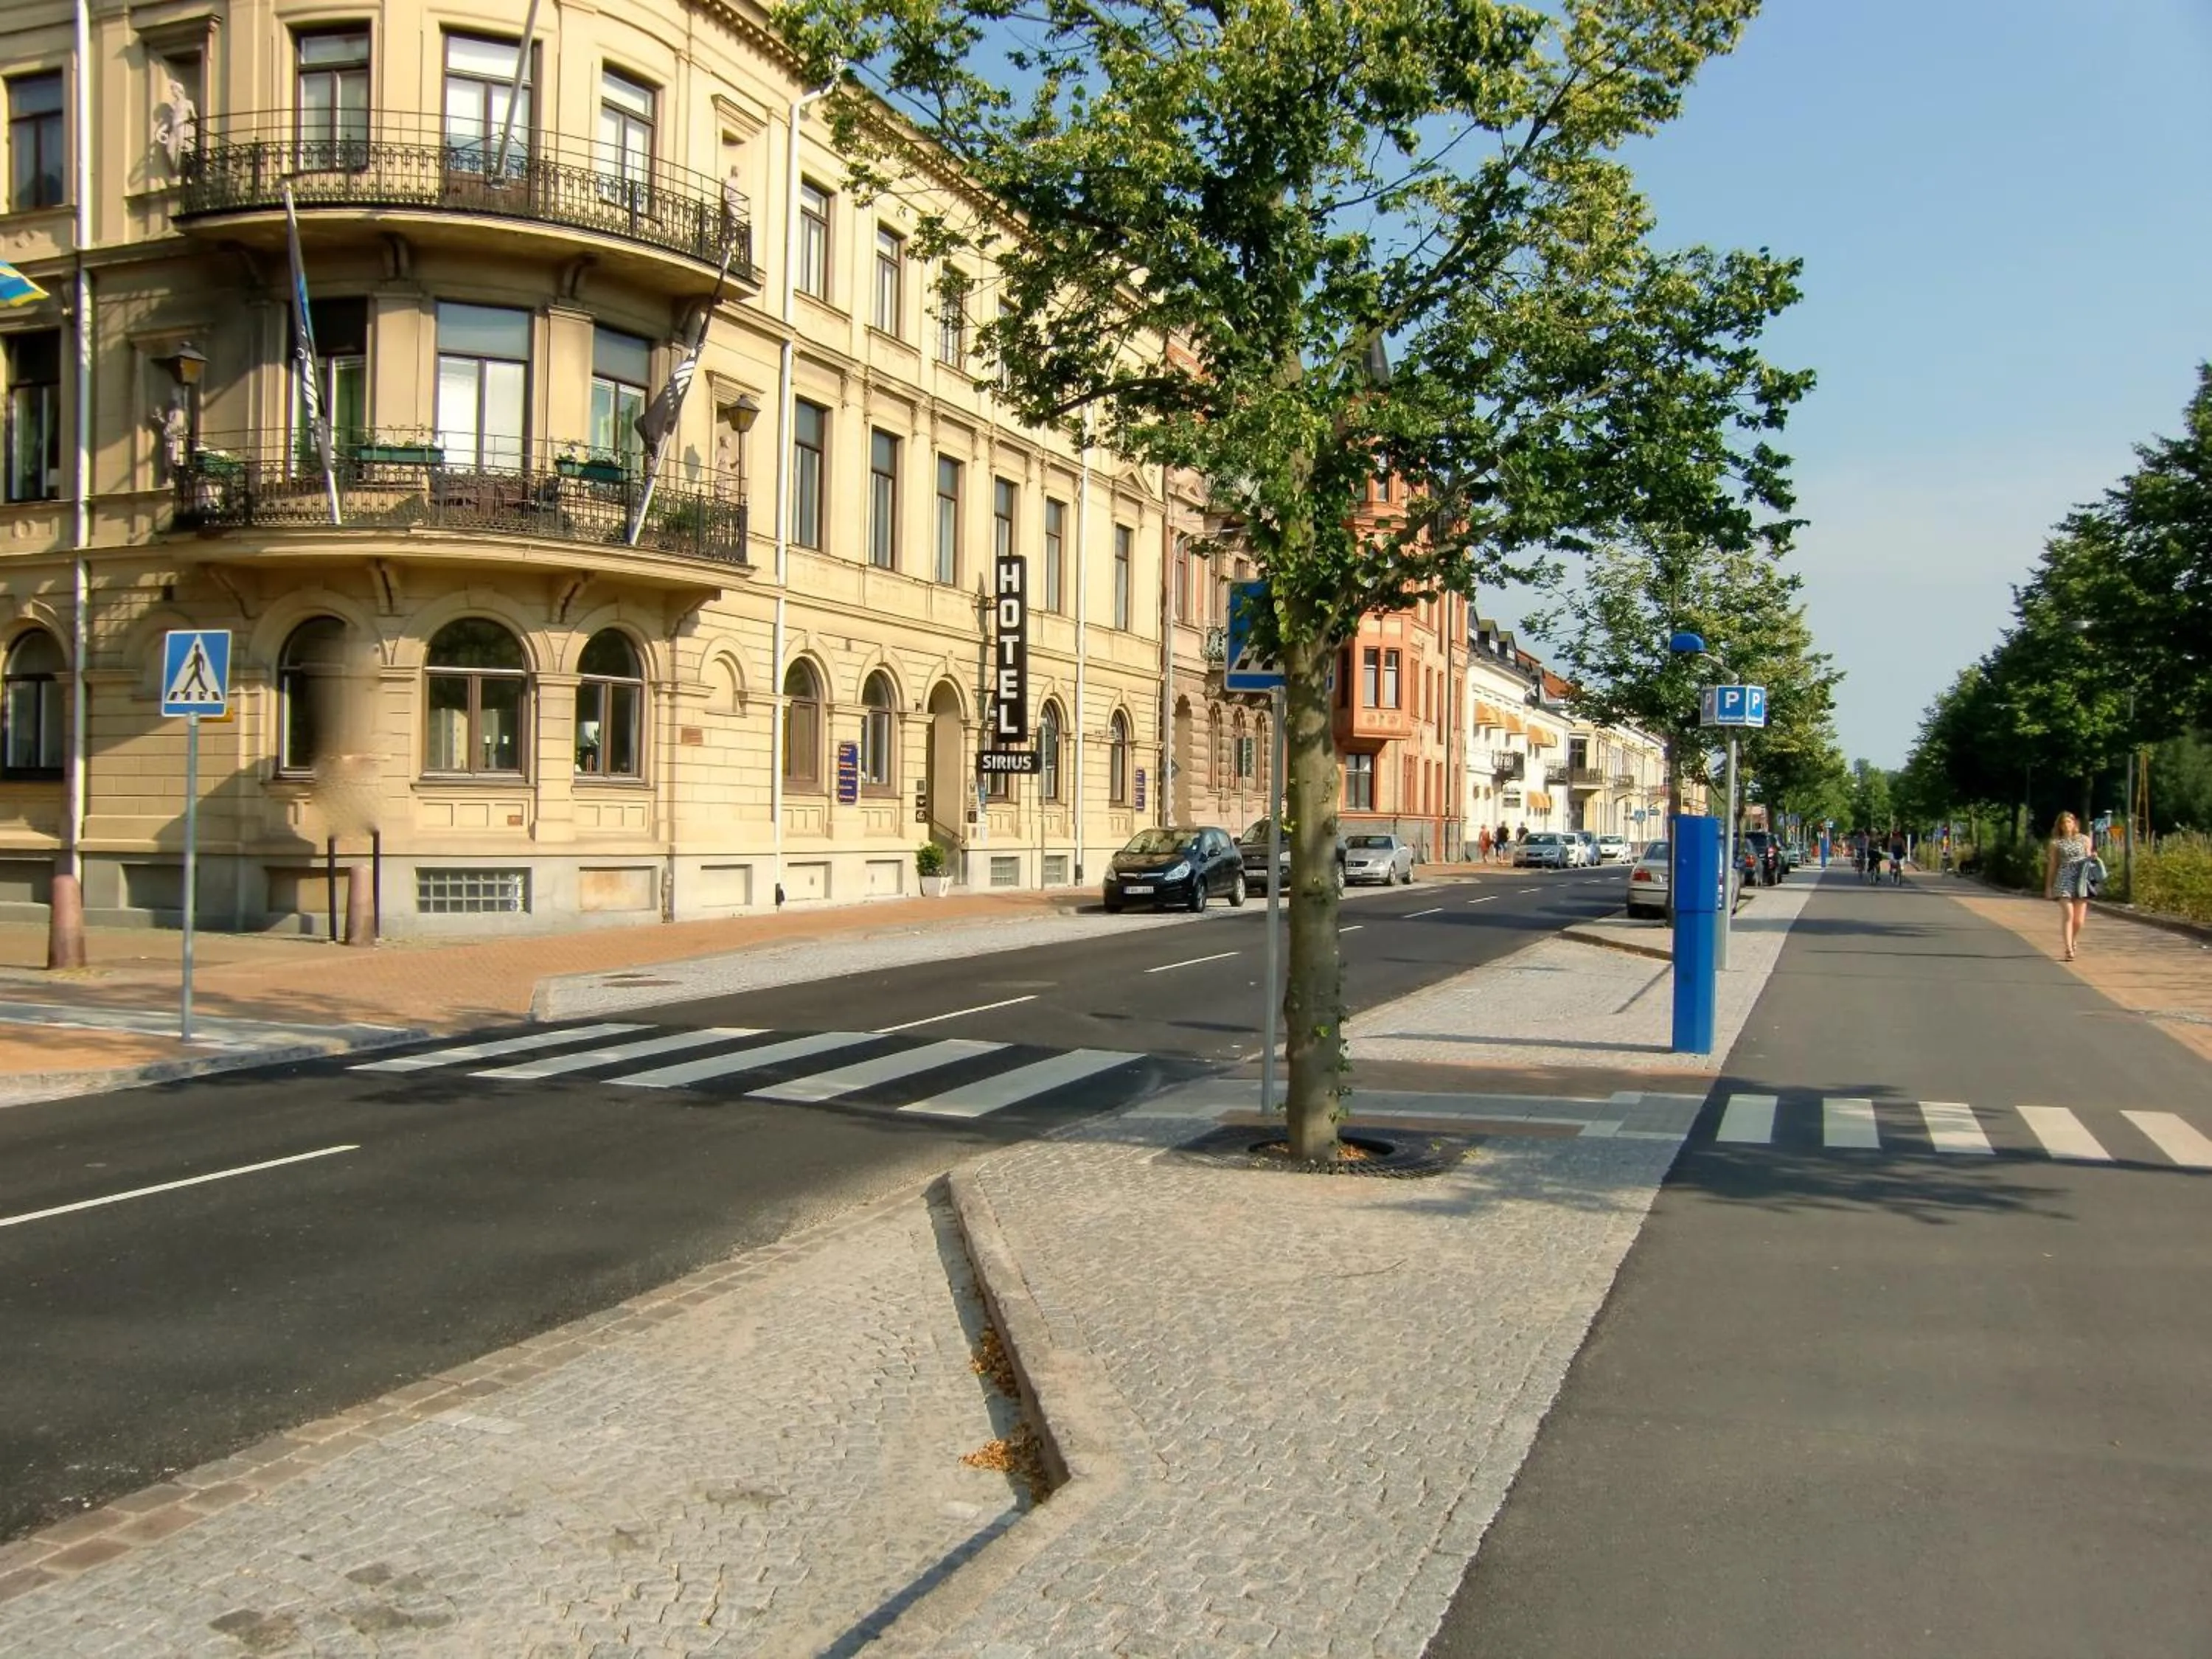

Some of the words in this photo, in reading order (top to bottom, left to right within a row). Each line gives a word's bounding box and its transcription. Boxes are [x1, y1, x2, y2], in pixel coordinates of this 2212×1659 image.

[999, 563, 1020, 734] HOTEL
[1725, 692, 1739, 709] P
[1752, 692, 1760, 709] P
[982, 754, 1032, 769] SIRIUS
